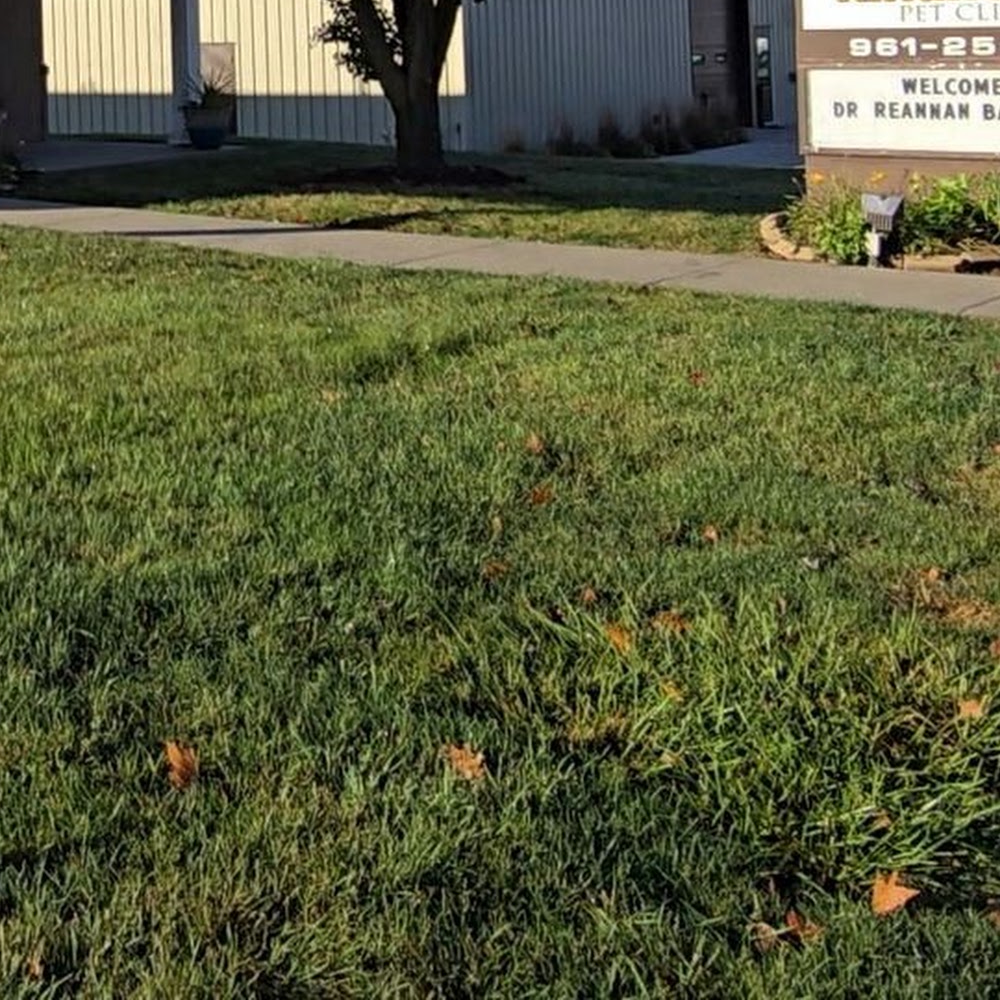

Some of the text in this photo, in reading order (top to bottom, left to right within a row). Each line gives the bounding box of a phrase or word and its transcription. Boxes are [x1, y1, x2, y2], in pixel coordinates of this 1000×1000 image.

[900, 4, 945, 22] PET
[849, 36, 996, 57] 961-25
[902, 78, 1000, 96] WELCOME
[833, 101, 1000, 121] DR REANNAN B
